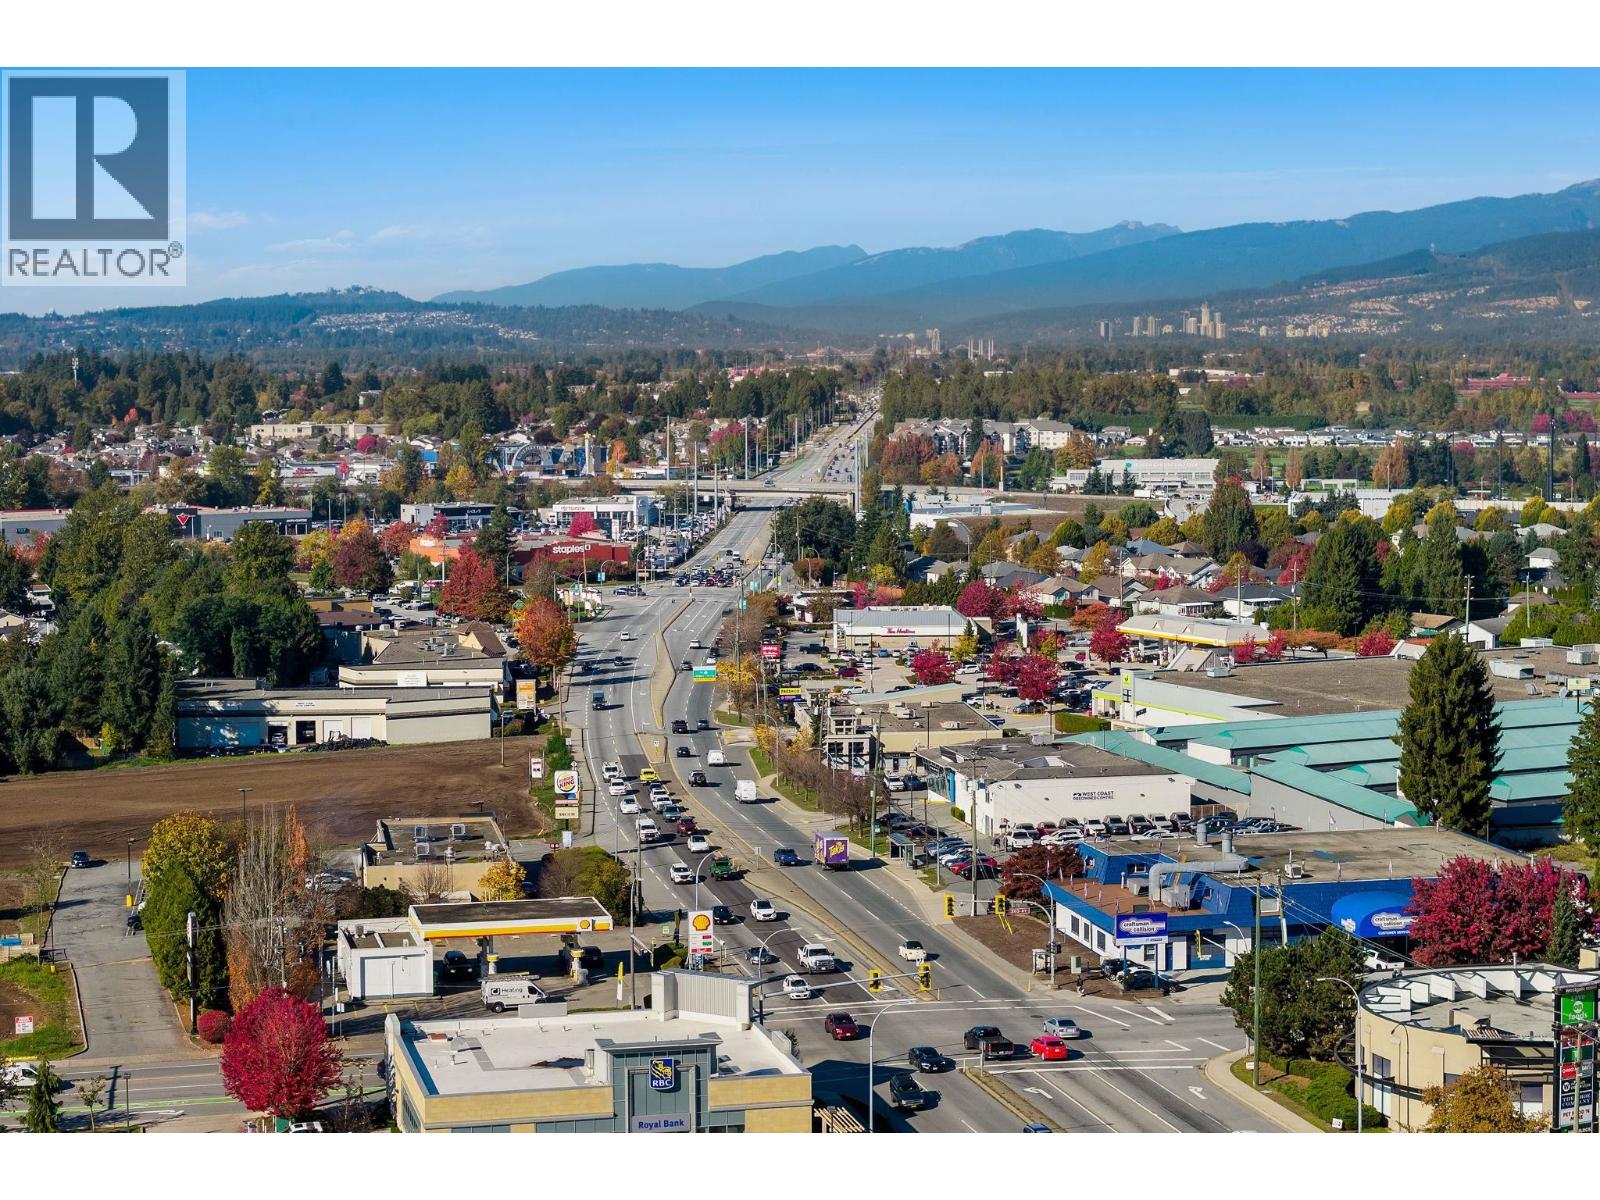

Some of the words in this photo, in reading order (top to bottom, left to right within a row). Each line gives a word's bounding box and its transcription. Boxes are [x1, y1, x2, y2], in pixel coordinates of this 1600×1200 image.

[552, 545, 585, 554] staples
[560, 780, 575, 788] KING
[1568, 1011, 1588, 1020] foods
[652, 1079, 672, 1087] RBC
[638, 1121, 661, 1130] Royal
[663, 1118, 685, 1128] Bank
